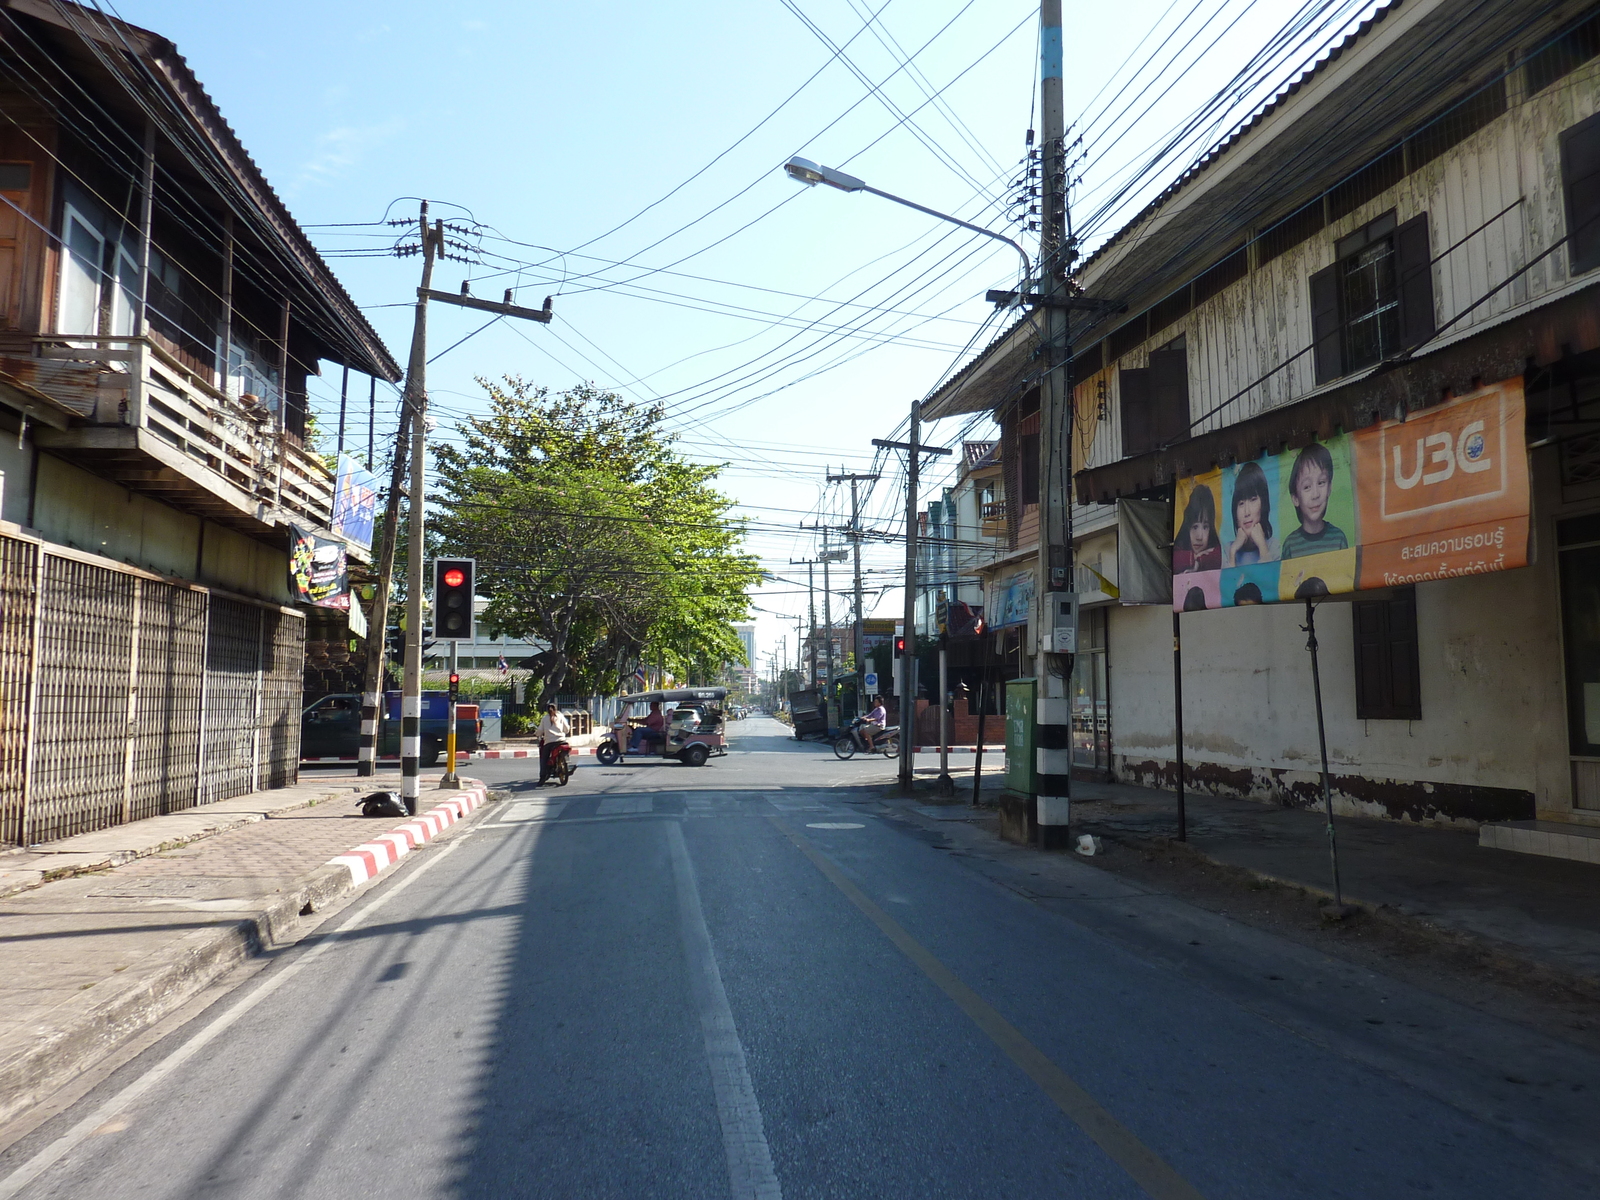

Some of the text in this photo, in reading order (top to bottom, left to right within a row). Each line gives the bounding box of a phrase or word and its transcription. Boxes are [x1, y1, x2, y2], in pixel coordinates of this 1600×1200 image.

[1401, 526, 1505, 560] สะสมความรอบรู้
